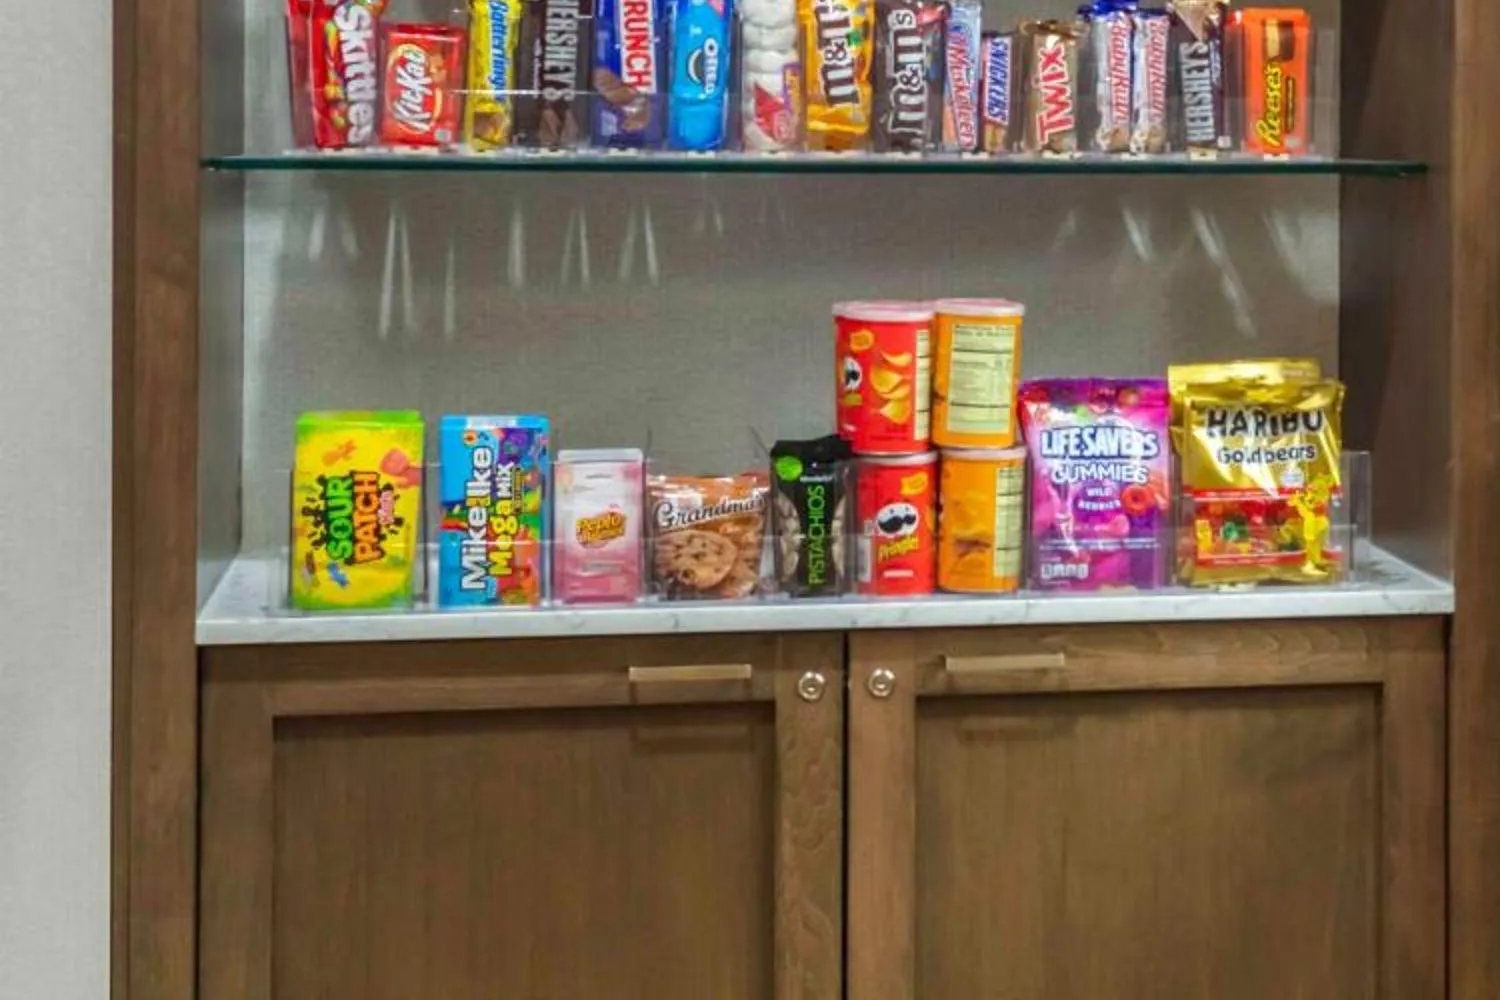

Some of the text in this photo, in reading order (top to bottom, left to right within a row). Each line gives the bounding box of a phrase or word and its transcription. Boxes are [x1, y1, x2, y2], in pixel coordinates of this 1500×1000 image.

[333, 2, 376, 144] Skittles
[703, 38, 720, 94] OREO
[987, 38, 1009, 122] SNICKERS
[1037, 42, 1076, 145] TWIX
[1178, 40, 1216, 142] HERSHEY'S
[467, 446, 494, 498] Ike
[1052, 463, 1149, 484] GUMMIES
[1217, 441, 1317, 464] Goldbears
[326, 475, 354, 562] SOUR
[353, 472, 380, 564] PATCH
[461, 505, 490, 591] Mike
[489, 498, 520, 577] Mega
[807, 484, 826, 586] PISTACHIOS
